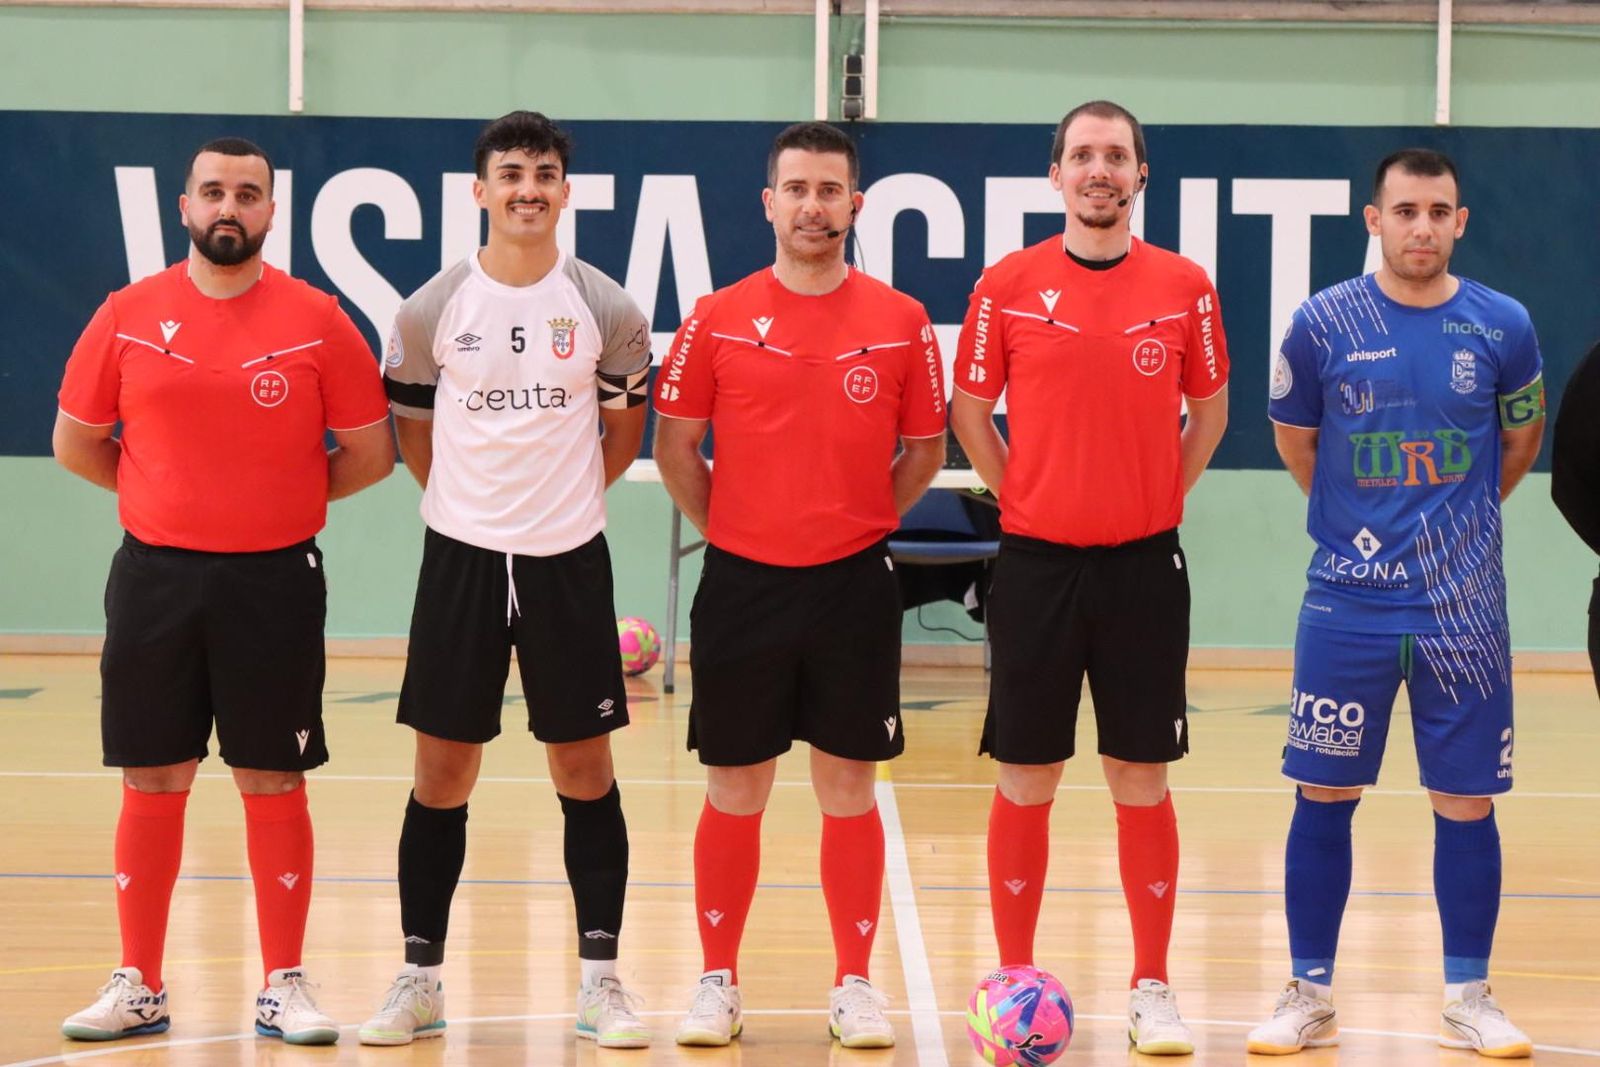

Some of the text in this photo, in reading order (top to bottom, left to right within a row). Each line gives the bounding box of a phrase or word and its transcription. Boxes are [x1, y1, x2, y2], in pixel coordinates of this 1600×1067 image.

[511, 326, 525, 354] 5
[1346, 347, 1397, 362] uhlsport
[1505, 394, 1533, 424] C
